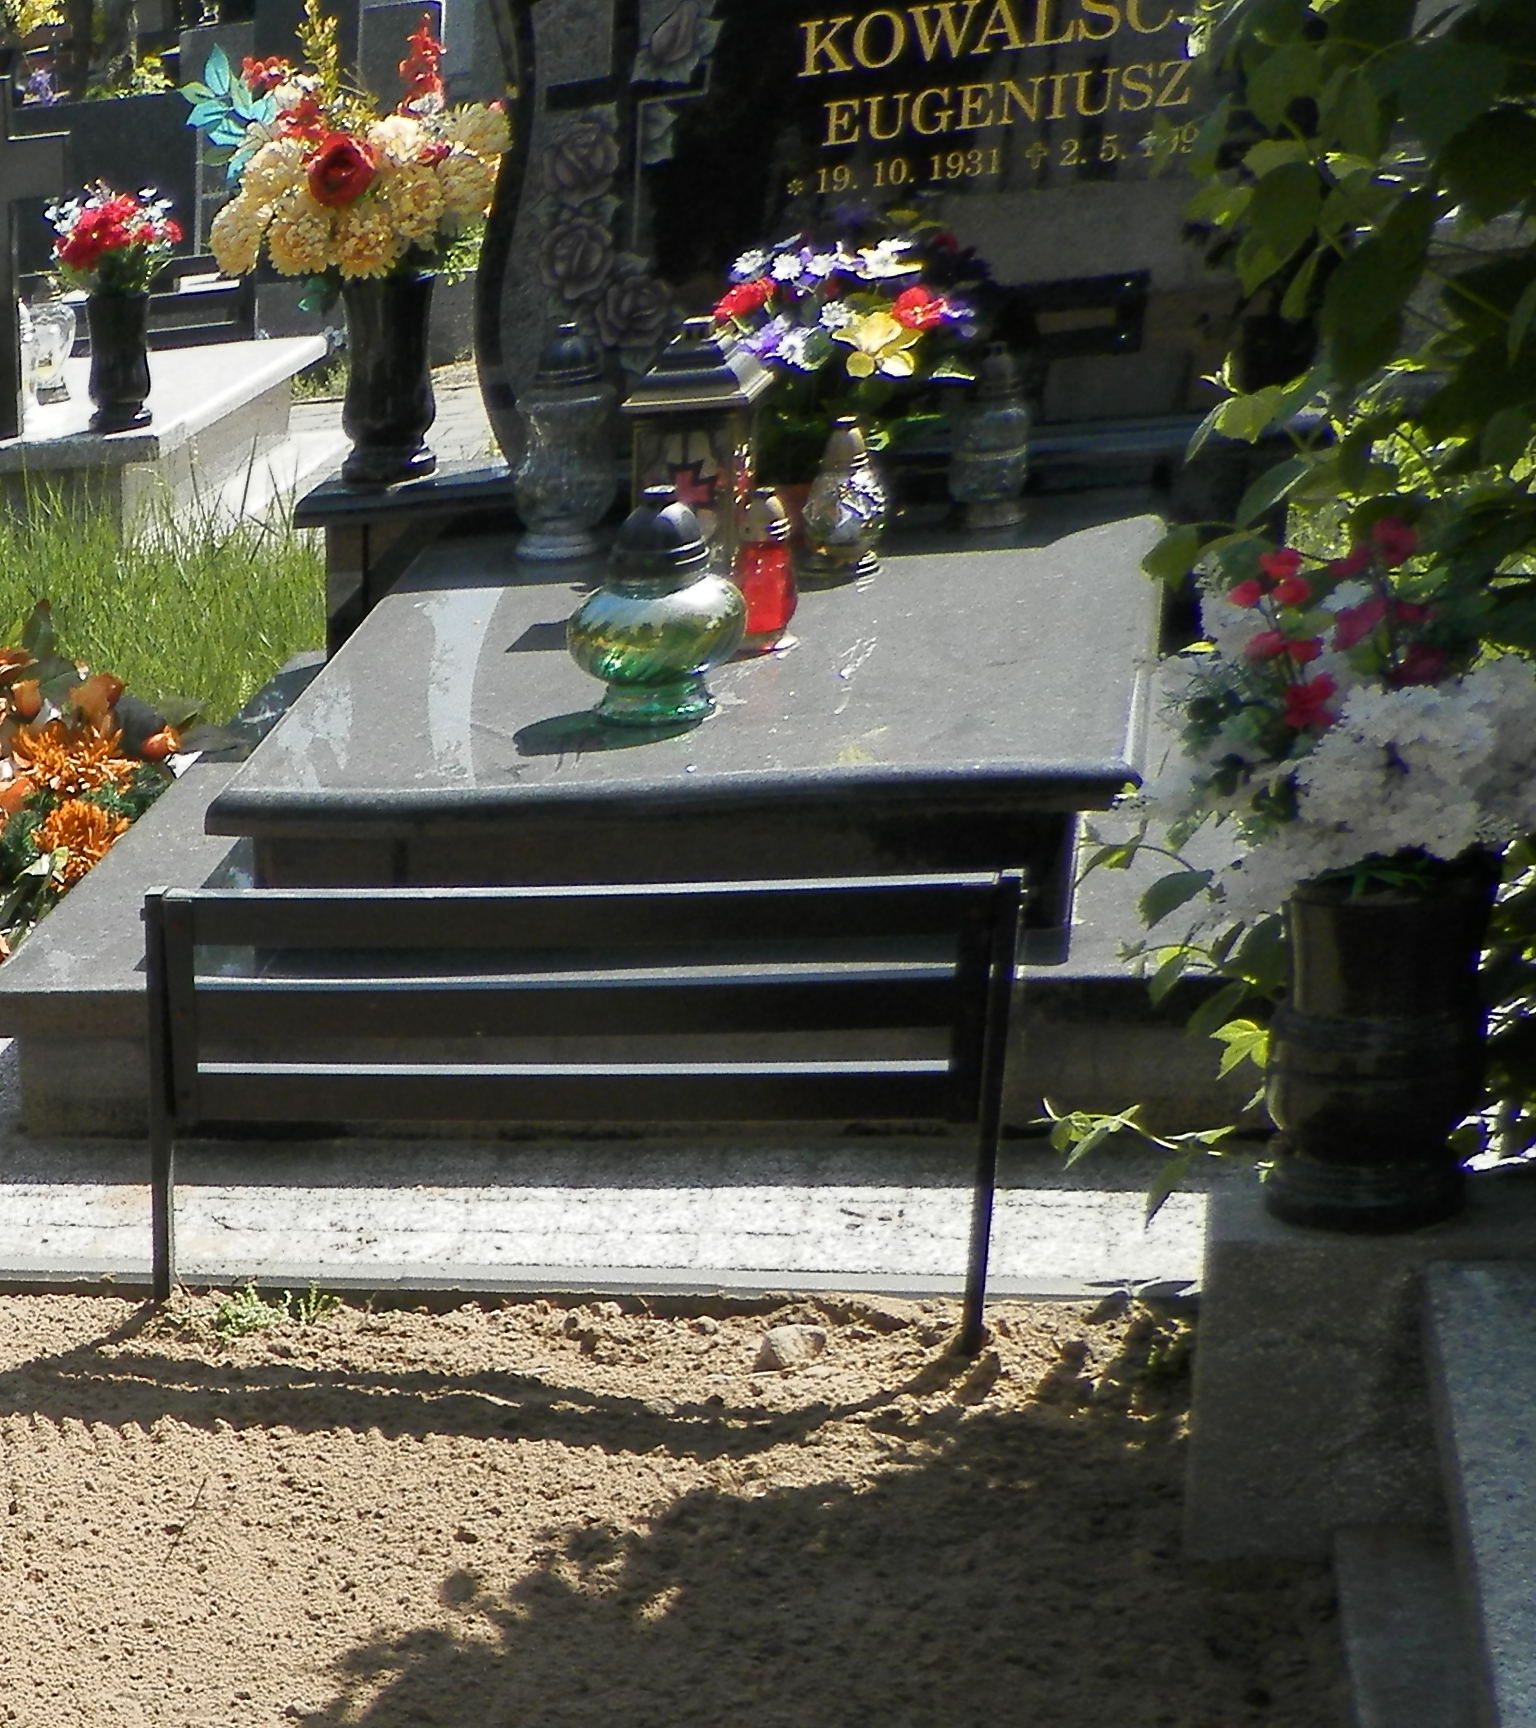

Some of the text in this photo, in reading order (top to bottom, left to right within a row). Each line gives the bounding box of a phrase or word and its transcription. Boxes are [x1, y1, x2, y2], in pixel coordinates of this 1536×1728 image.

[797, 0, 1177, 77] KOWALSC
[821, 60, 1192, 147] EUGENIUSZ
[930, 147, 1002, 181] 1931
